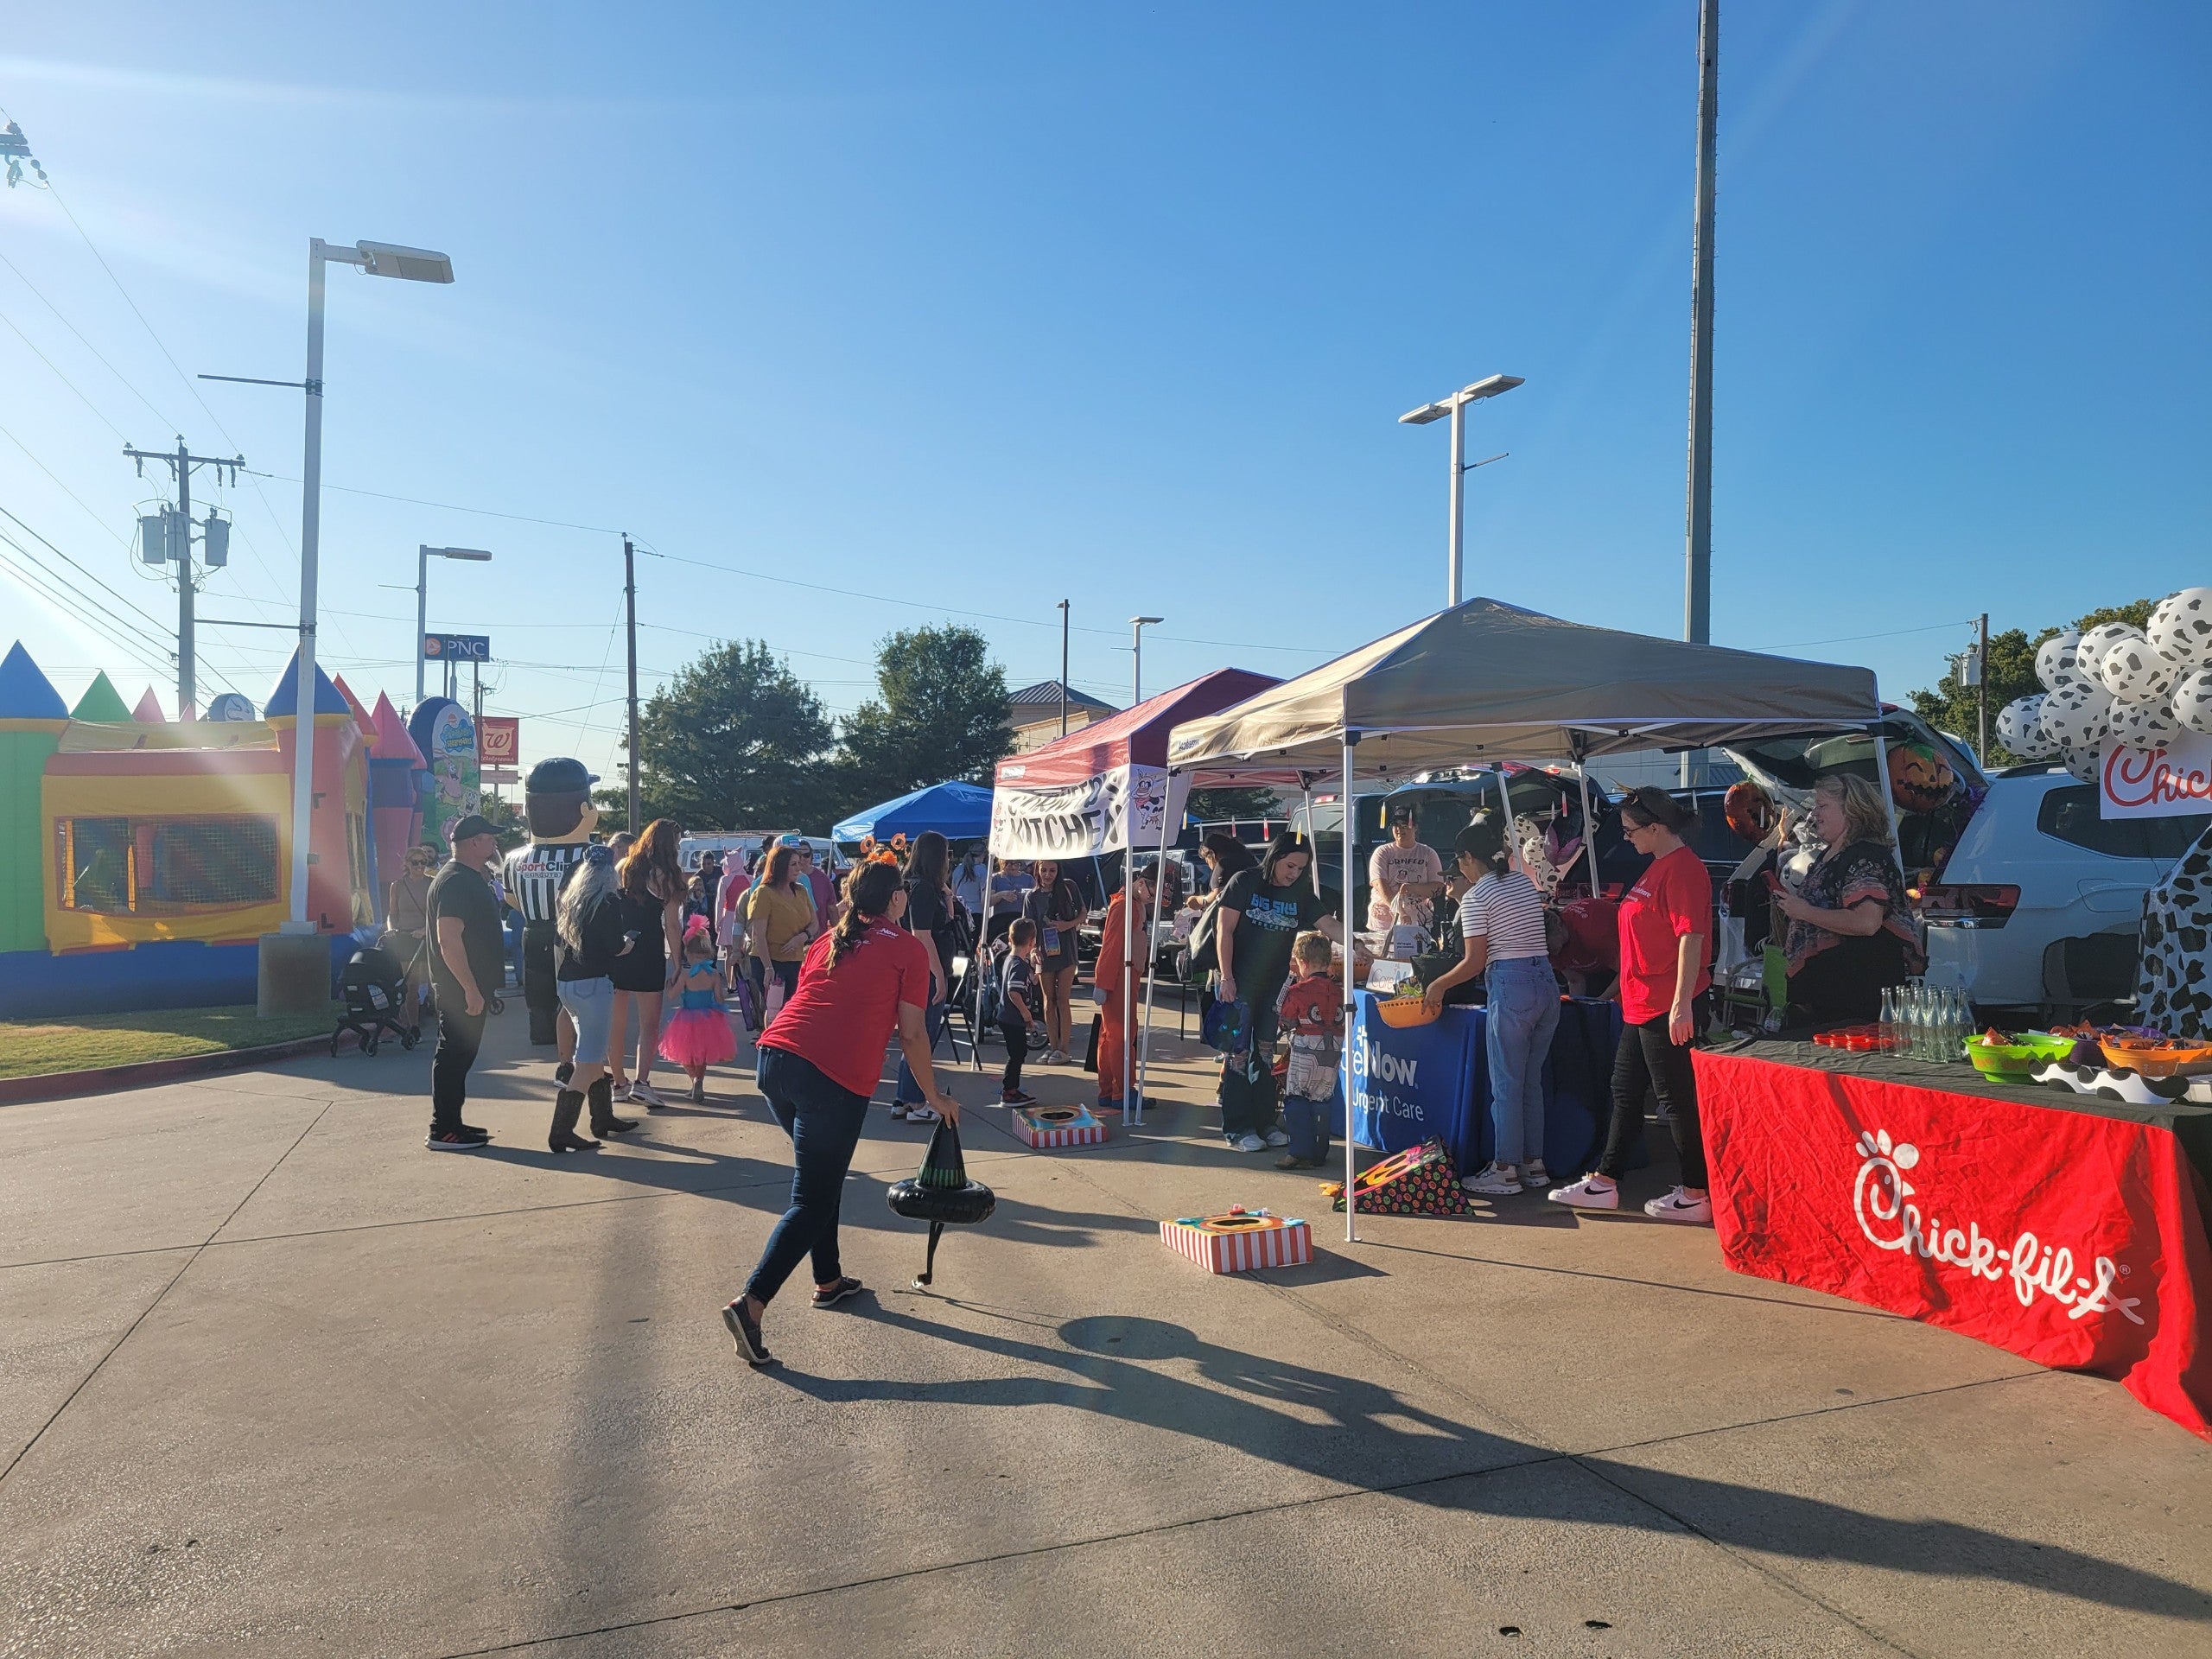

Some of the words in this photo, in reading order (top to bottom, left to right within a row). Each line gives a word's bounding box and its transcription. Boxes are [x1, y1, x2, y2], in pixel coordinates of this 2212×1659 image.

[448, 640, 485, 656] PNC
[2104, 744, 2212, 807] Chic
[1005, 804, 1123, 852] KITCHEN
[1250, 893, 1270, 911] BIG
[1272, 899, 1298, 916] SKY
[1393, 1096, 1425, 1122] Care
[1853, 1154, 2145, 1325] Chick-fil-A
